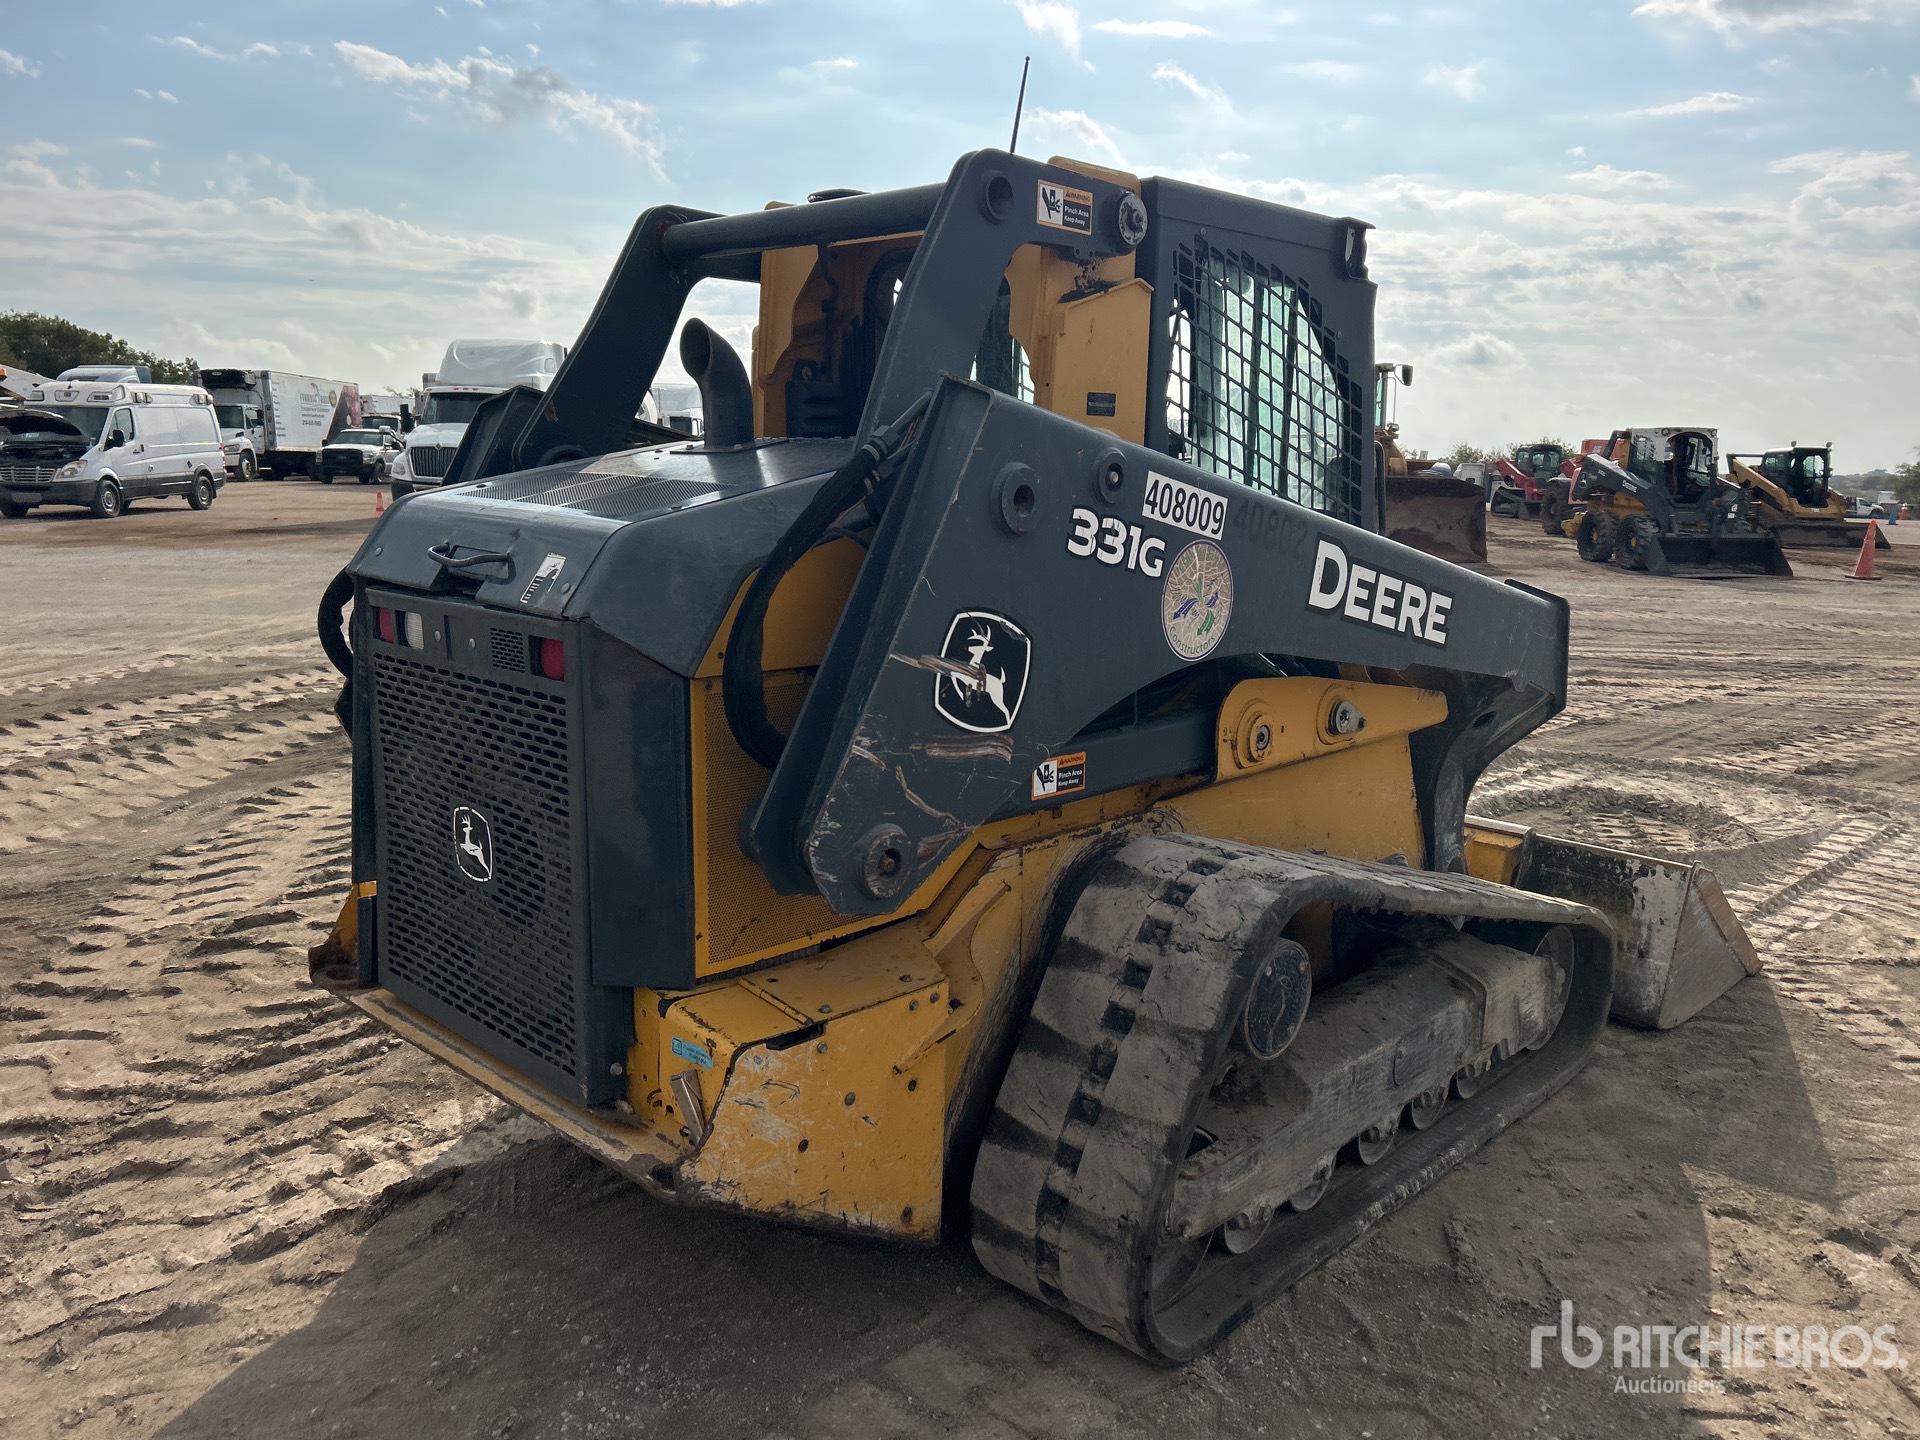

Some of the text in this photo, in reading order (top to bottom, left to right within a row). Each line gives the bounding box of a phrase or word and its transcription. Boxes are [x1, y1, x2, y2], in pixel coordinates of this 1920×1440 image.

[1064, 206, 1089, 217] Pinch Area
[1064, 215, 1085, 226] Keep Away
[1146, 478, 1225, 536] 408009
[1067, 508, 1166, 578] 331G
[1307, 539, 1453, 645] DEERE
[1169, 626, 1216, 655] Constructors
[1058, 770, 1072, 778] Pinch
